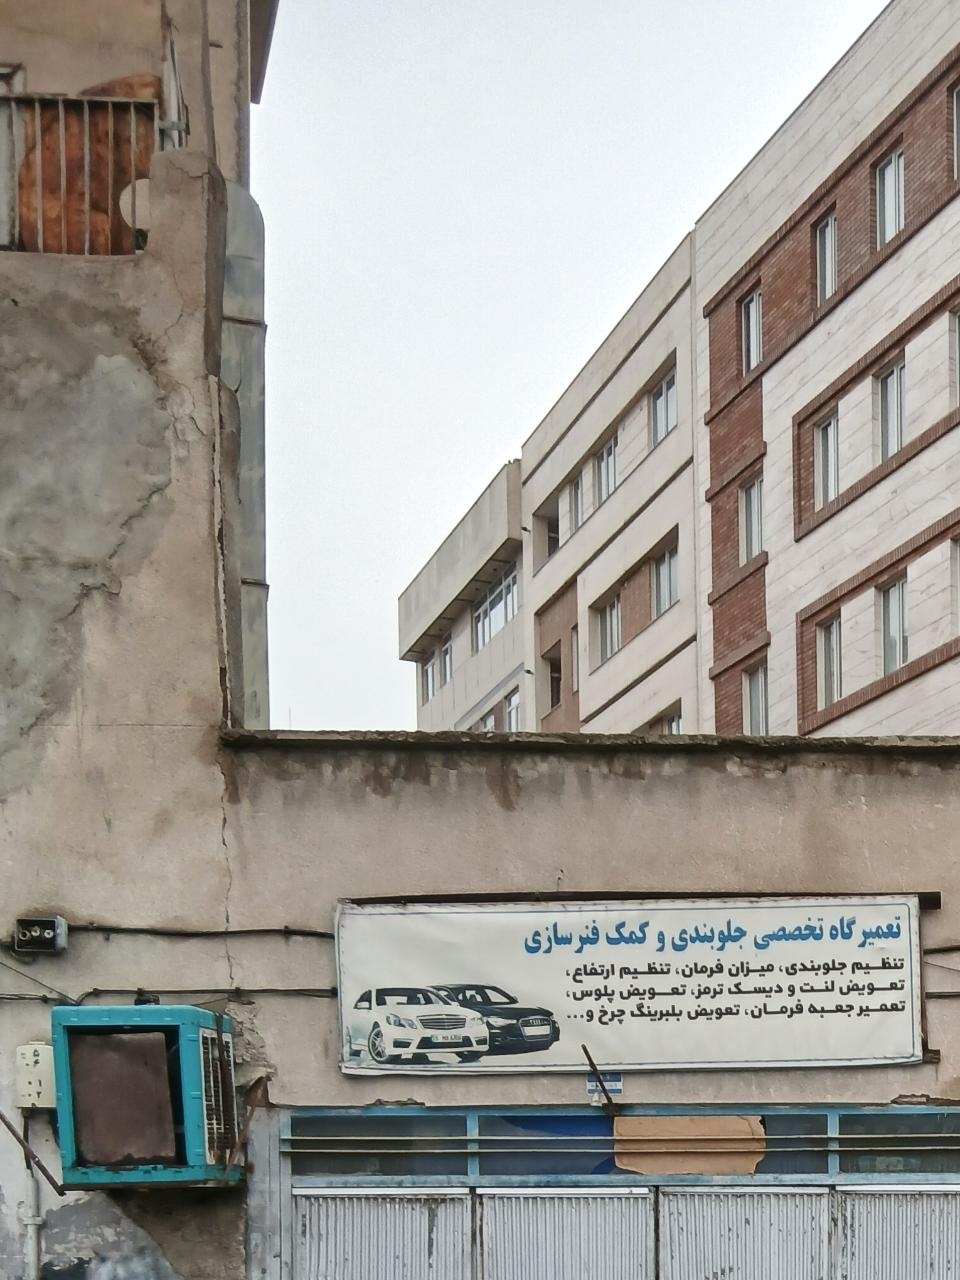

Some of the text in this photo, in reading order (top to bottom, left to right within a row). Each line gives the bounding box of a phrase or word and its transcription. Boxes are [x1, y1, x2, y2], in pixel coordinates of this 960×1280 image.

[605, 920, 650, 946] کمک
[656, 930, 666, 953] و
[671, 918, 748, 952] جلوبندی
[753, 917, 824, 950] تخصصی
[619, 961, 672, 980] تنظیم
[727, 961, 775, 977] میزان
[851, 957, 905, 975] تنظیم
[619, 983, 688, 1001] تعویض
[727, 981, 784, 998] دیسک
[787, 983, 796, 997] و
[799, 980, 835, 993] لنت
[839, 979, 906, 996] تعویض
[597, 1004, 627, 1026] چرخ
[629, 1002, 683, 1022] بلبرینگ
[686, 1004, 741, 1021] تعویض
[807, 1003, 855, 1018] جعبه
[856, 1000, 906, 1018] تعمیر
